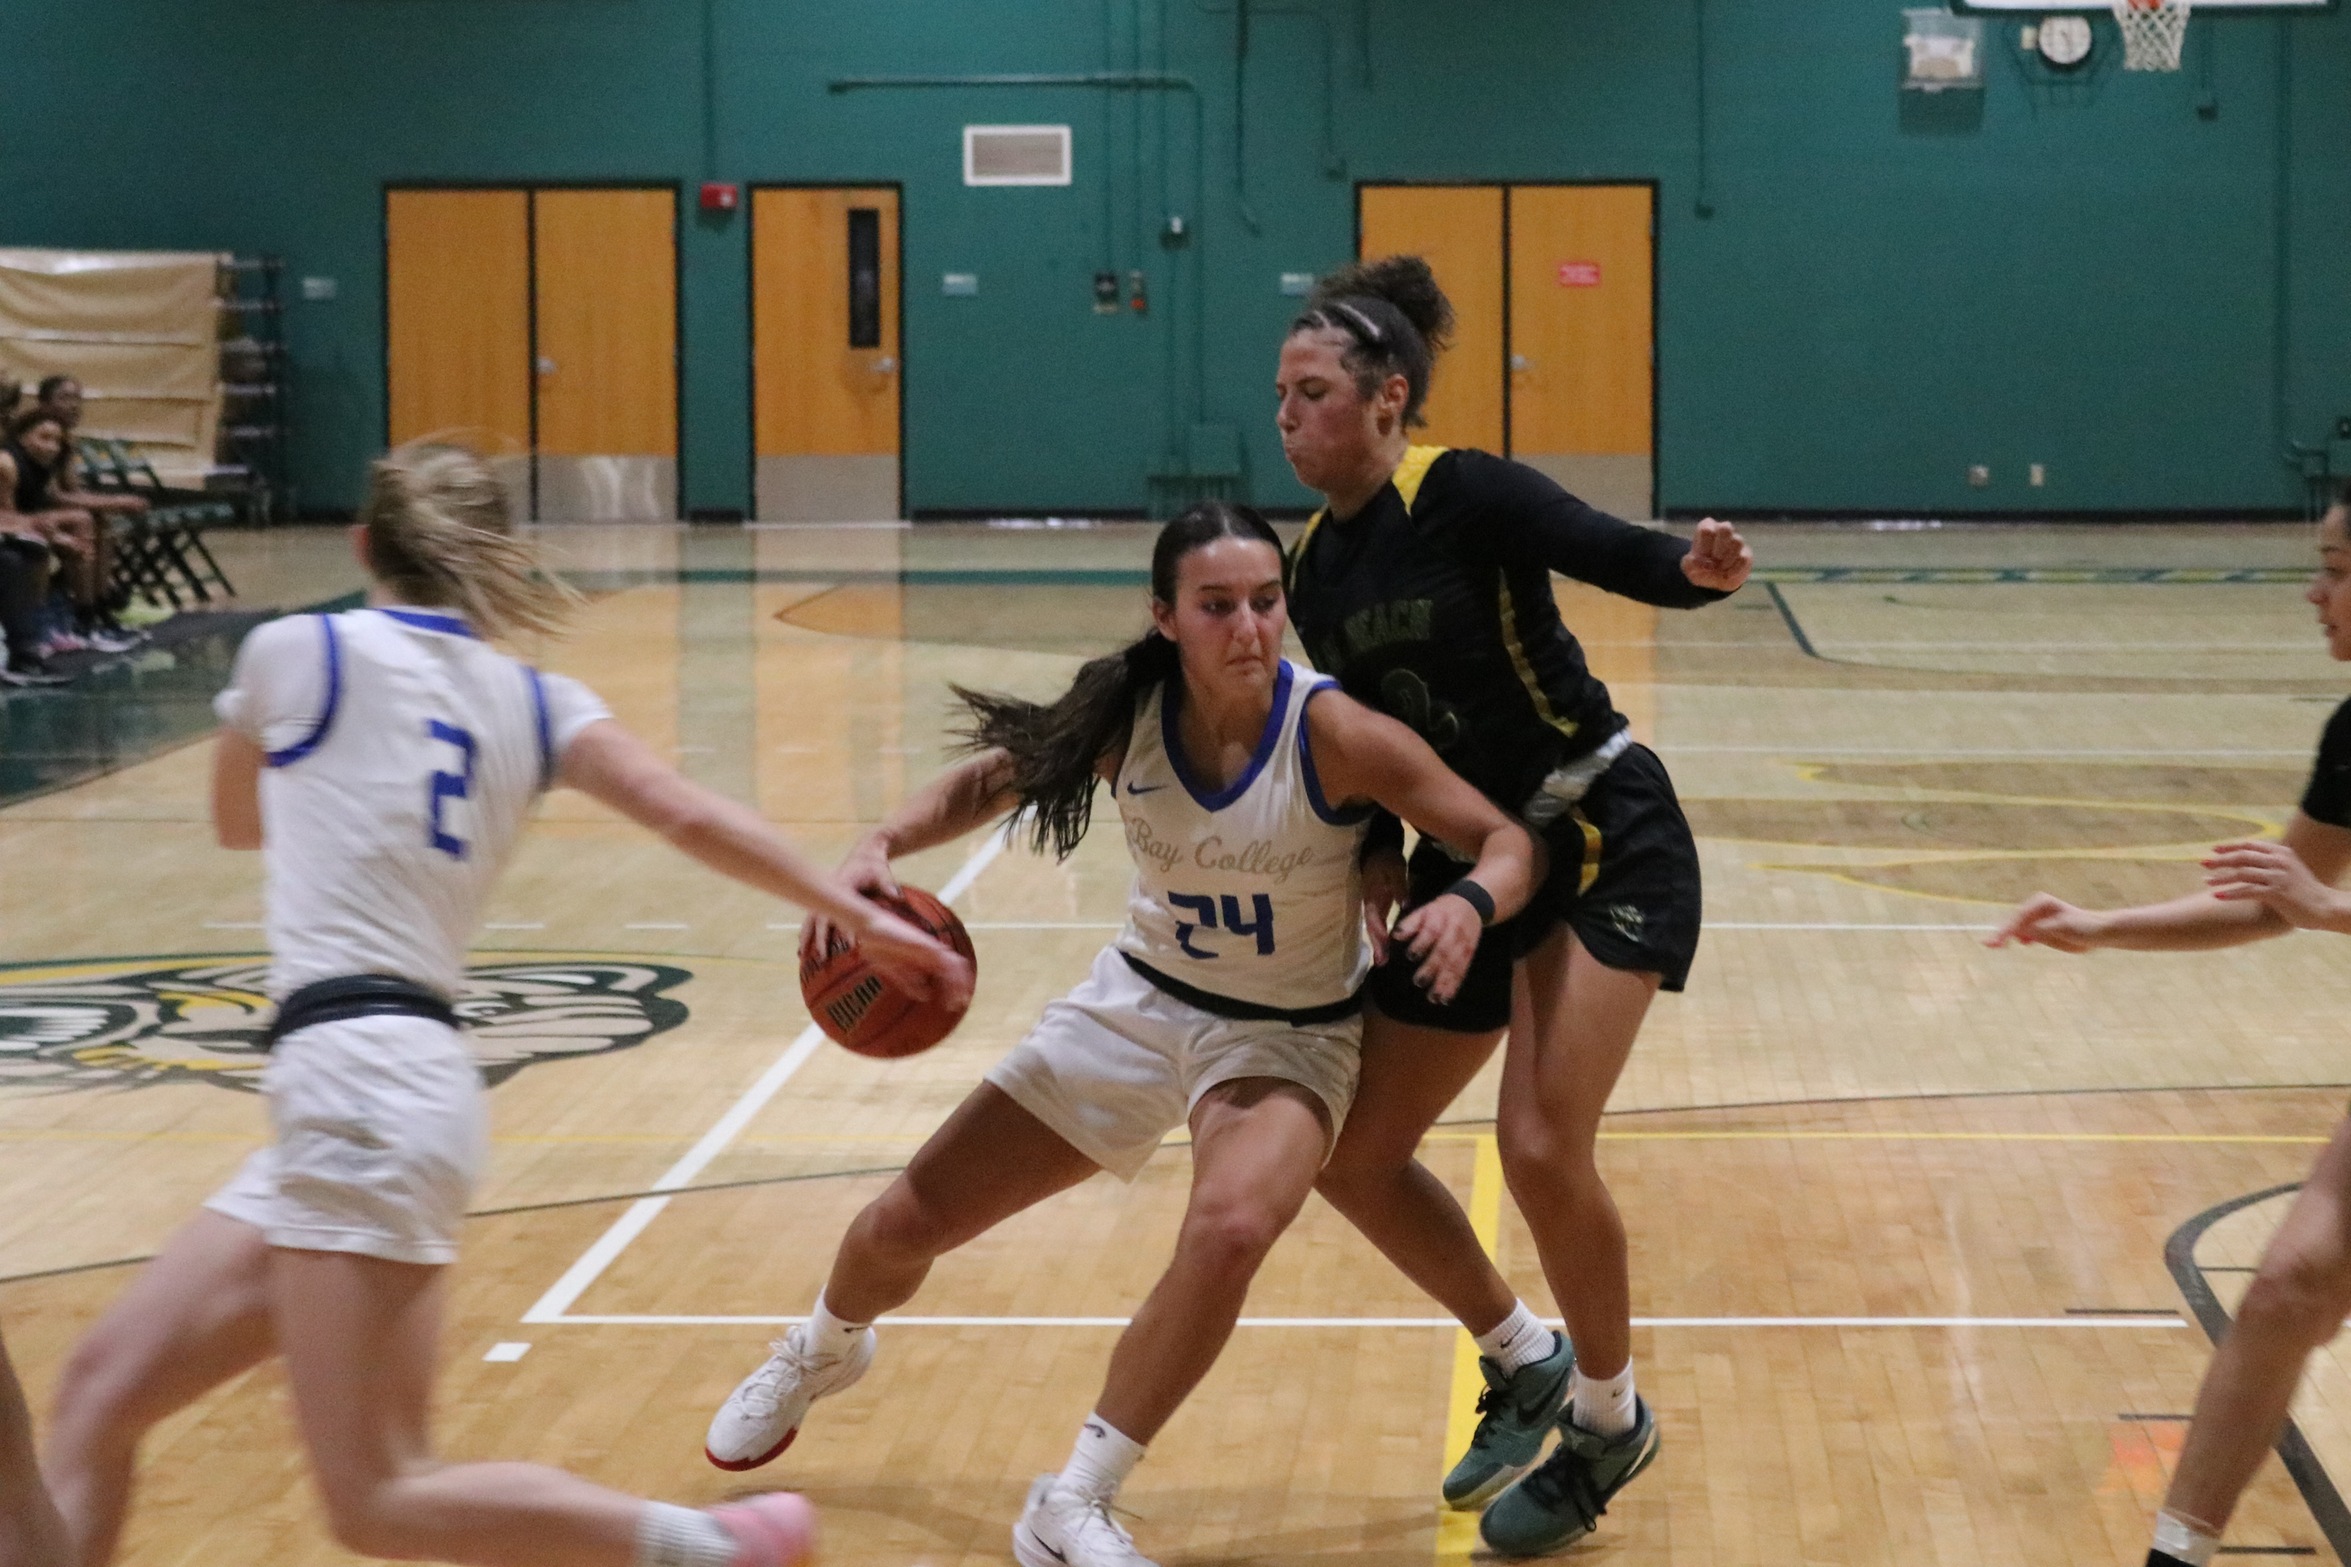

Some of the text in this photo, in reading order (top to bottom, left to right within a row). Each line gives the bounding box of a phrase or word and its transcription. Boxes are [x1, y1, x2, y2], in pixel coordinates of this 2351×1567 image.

[423, 716, 478, 862] 2
[1131, 817, 1313, 885] Bay College
[1167, 890, 1276, 960] 24
